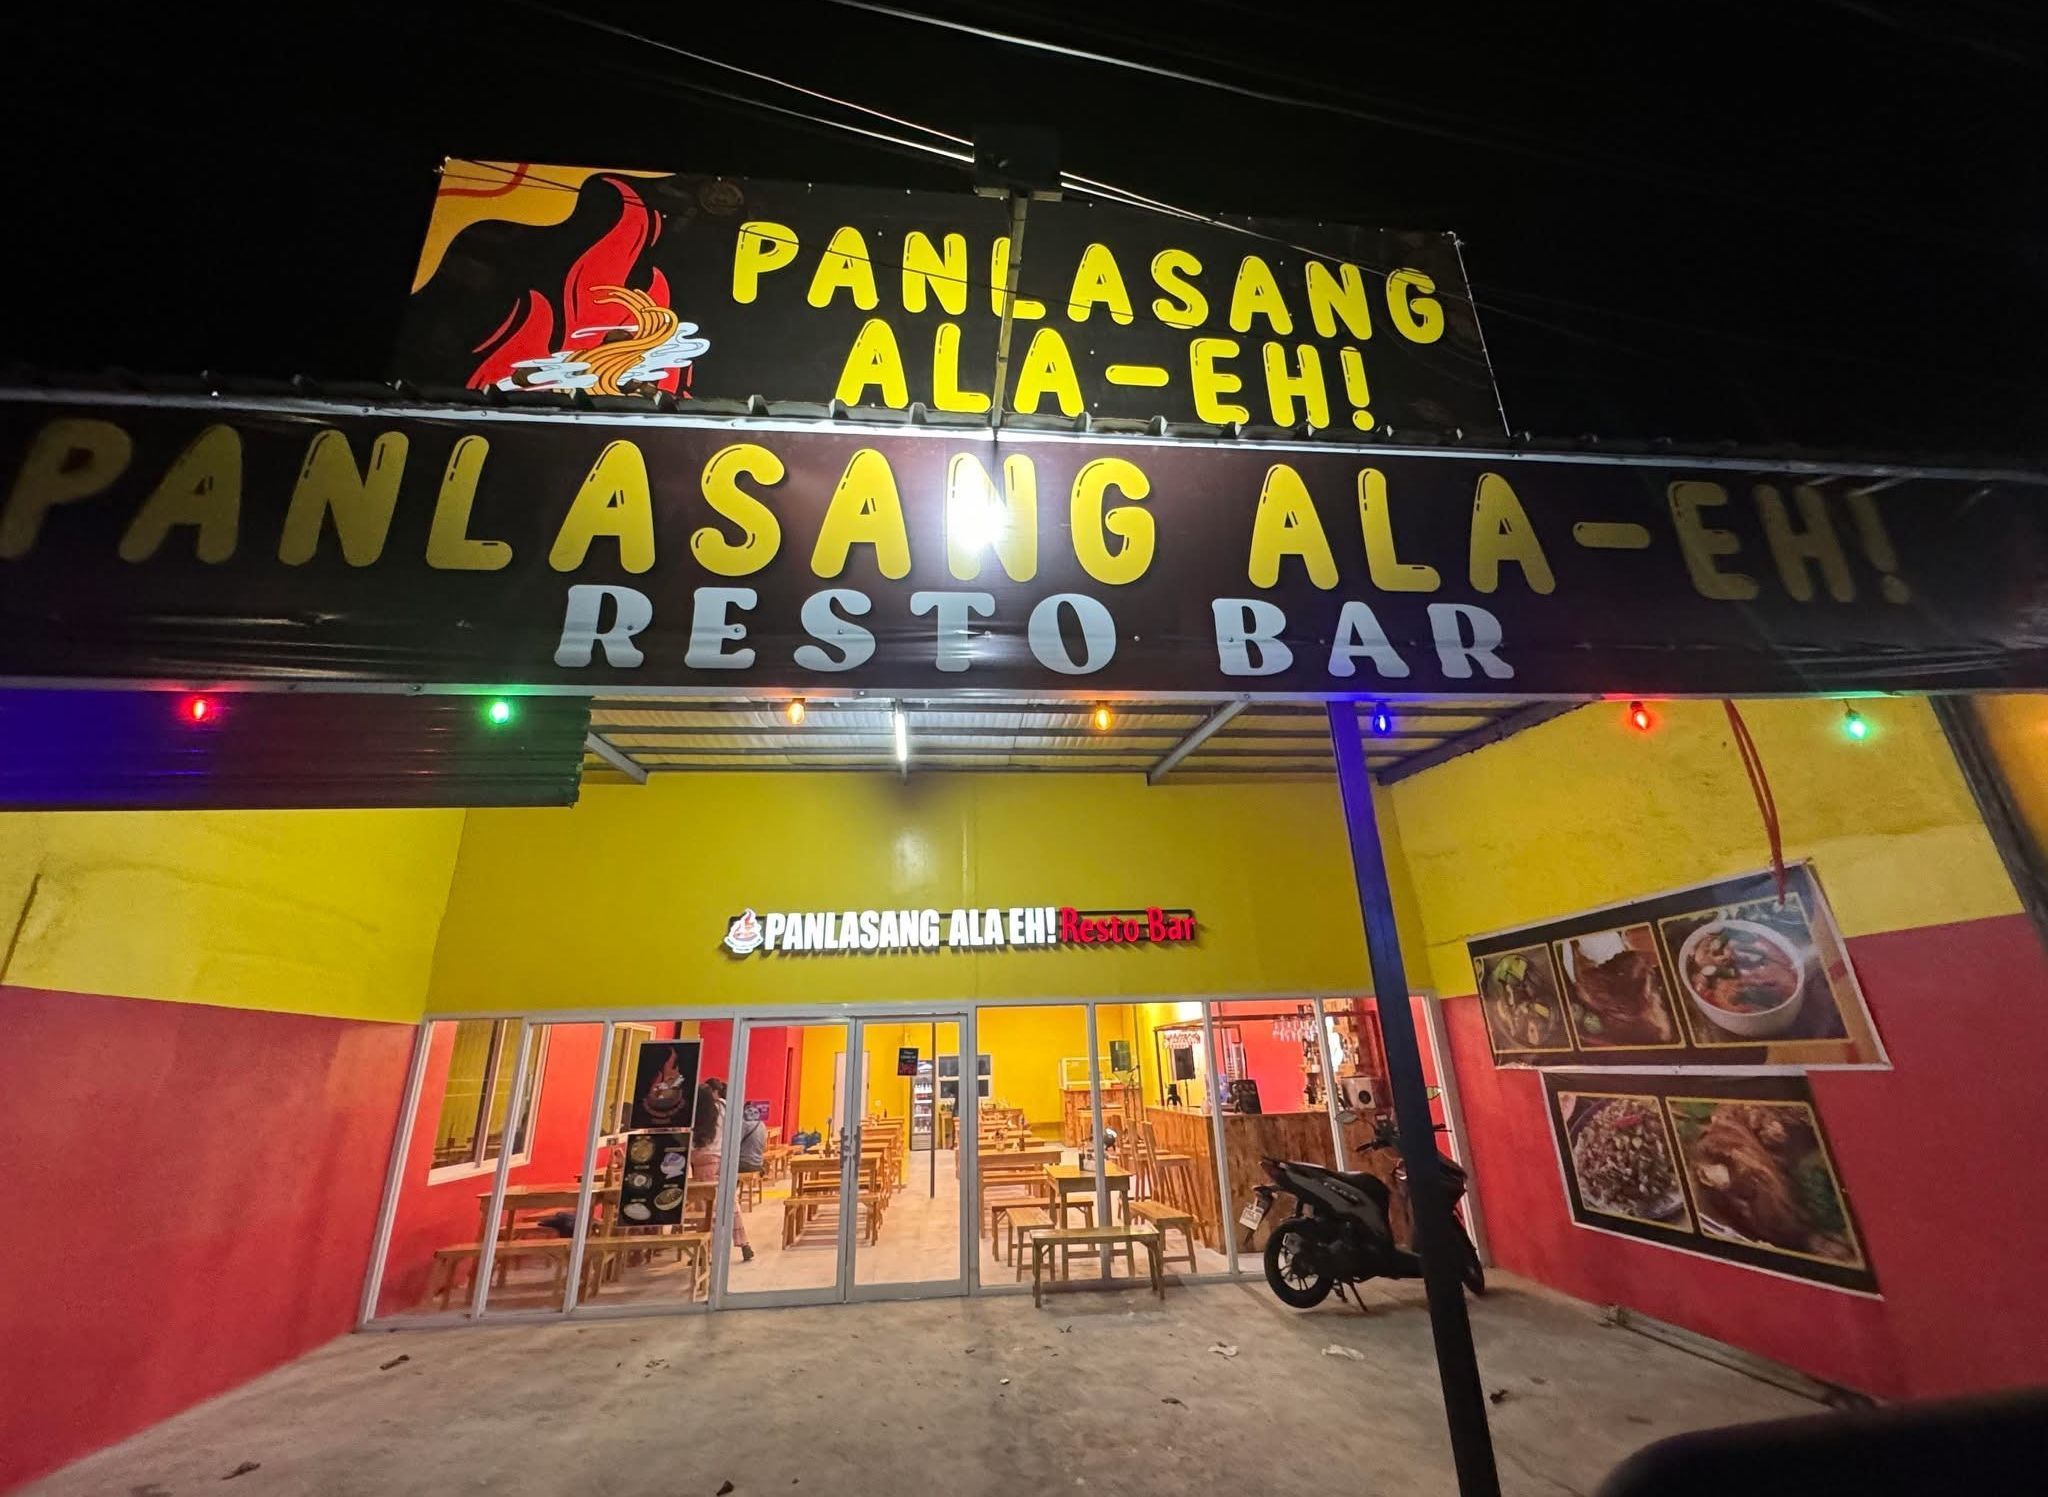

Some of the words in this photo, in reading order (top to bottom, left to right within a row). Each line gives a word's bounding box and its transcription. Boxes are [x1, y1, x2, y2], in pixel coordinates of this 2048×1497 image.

[732, 221, 1445, 344] PANLASANG
[835, 319, 1375, 431] ALA-EH!
[0, 418, 1155, 585] PANLASANG
[1248, 463, 1911, 605] ALA-EH!
[554, 584, 1117, 675] RESTO
[1212, 598, 1515, 679] BAR
[764, 909, 940, 951] PANLASANG
[948, 908, 1004, 947] ALA
[1009, 907, 1057, 944] EH!
[1060, 906, 1140, 943] Resto
[1144, 906, 1197, 943] Bar
